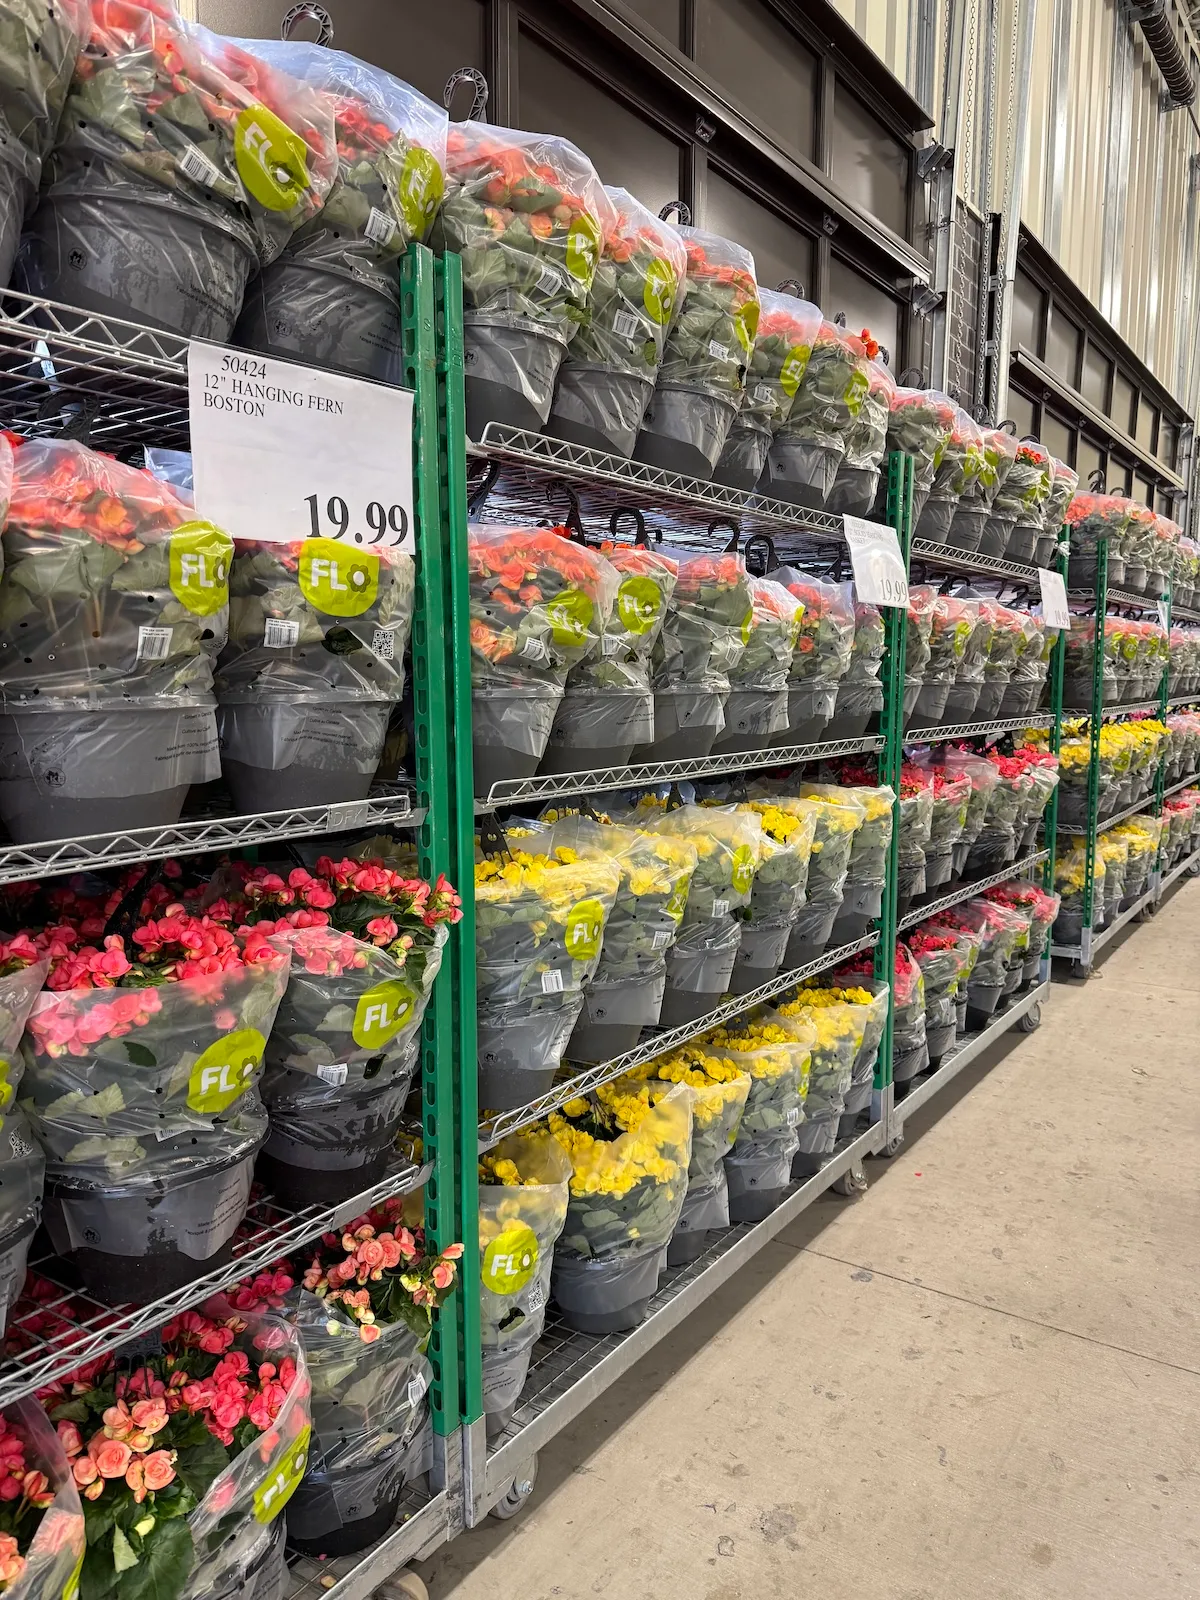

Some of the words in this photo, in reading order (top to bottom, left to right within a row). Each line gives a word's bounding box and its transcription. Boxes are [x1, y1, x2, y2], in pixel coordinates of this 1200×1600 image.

[220, 355, 267, 380] 50424
[203, 372, 226, 390] 12"
[231, 379, 304, 408] HANGING
[307, 394, 345, 416] FERN
[203, 392, 266, 418] BOSTON
[304, 493, 409, 547] 19.99
[880, 579, 909, 604] 19.99
